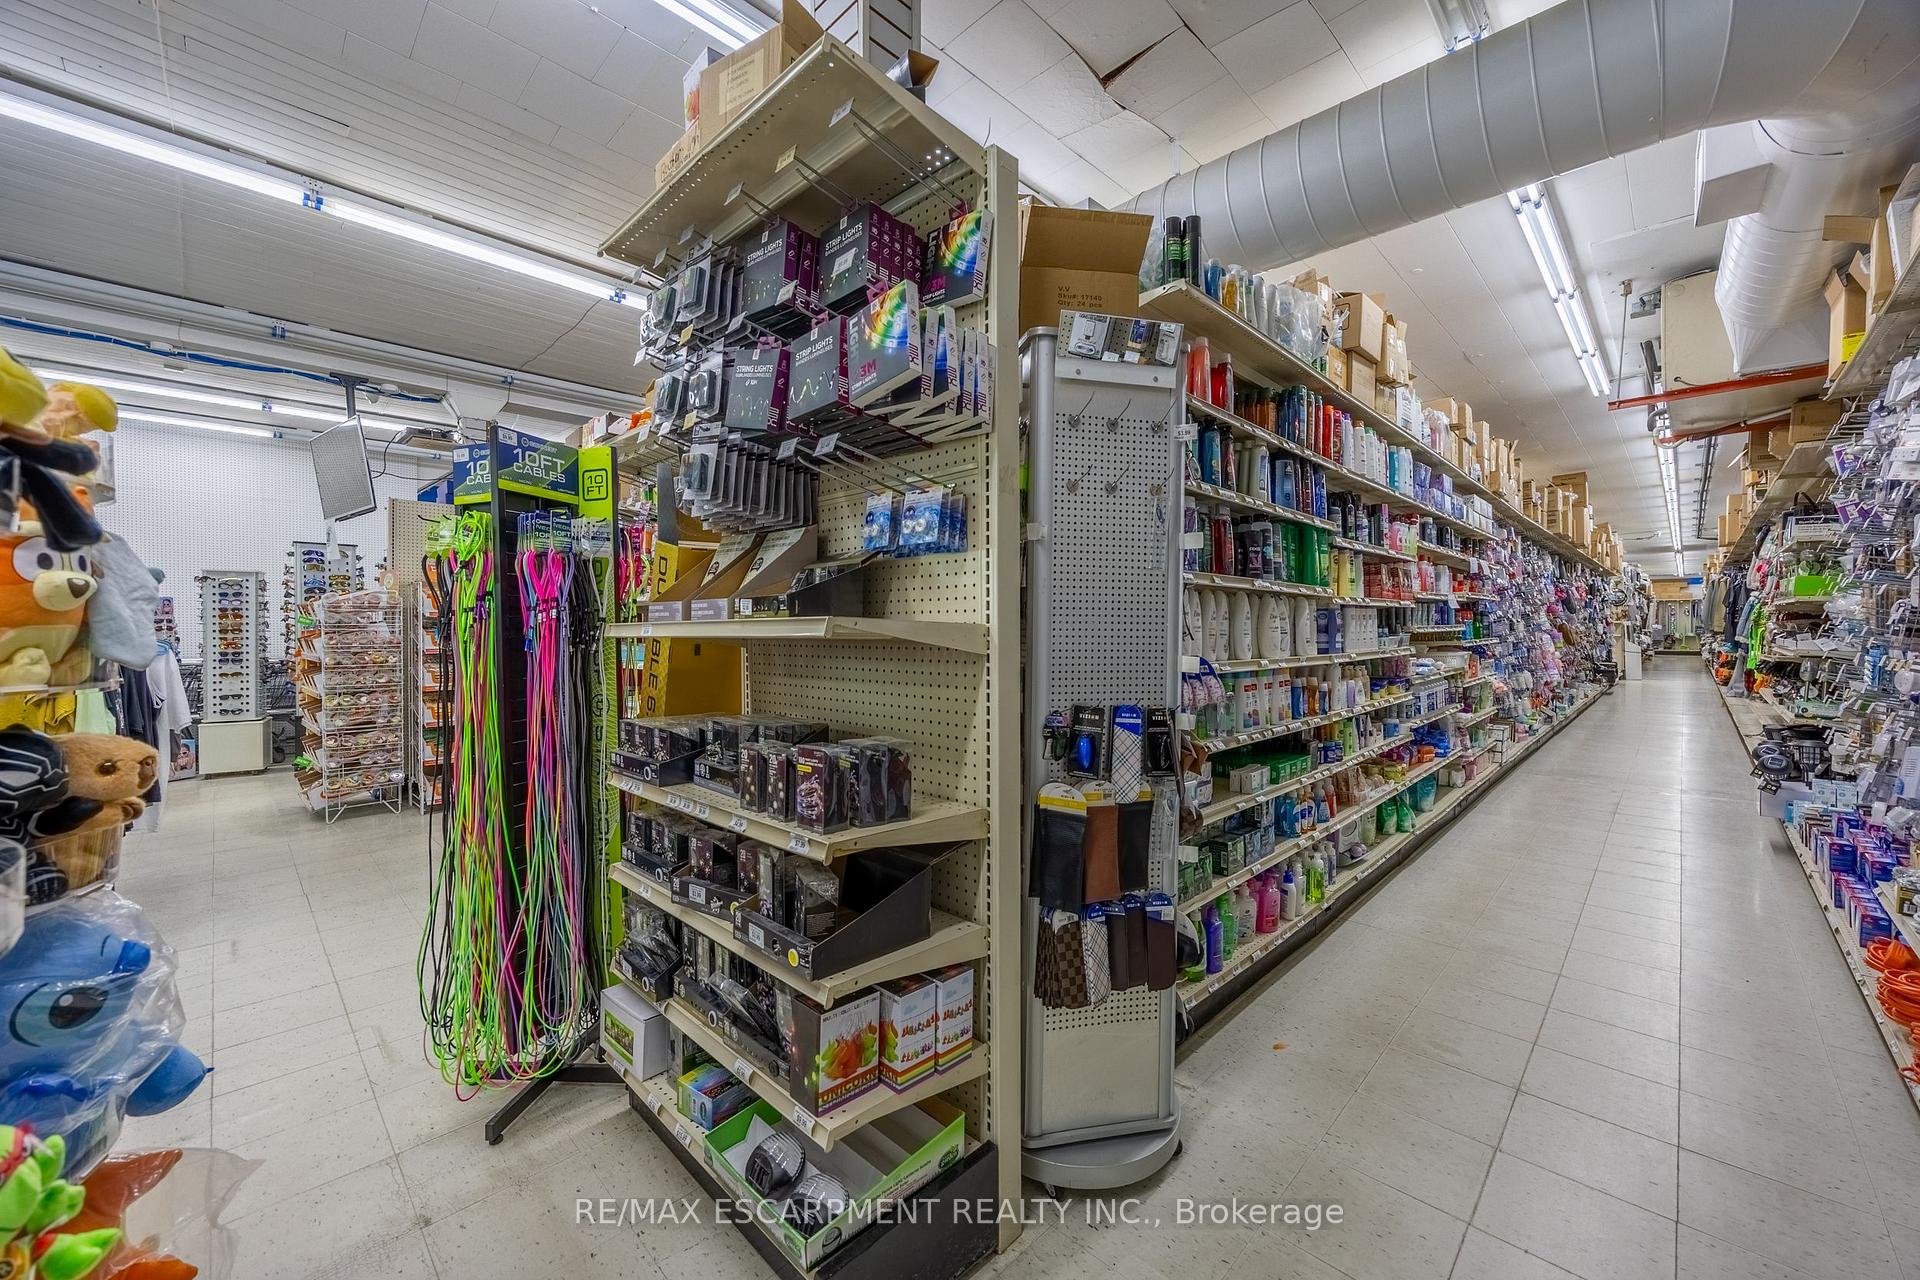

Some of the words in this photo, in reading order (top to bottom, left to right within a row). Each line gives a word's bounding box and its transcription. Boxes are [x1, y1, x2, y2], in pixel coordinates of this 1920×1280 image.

[842, 222, 863, 240] LIGHTS
[764, 239, 783, 257] LIGHTS
[812, 336, 834, 352] LIGHTS
[736, 365, 754, 373] STRING
[754, 364, 774, 373] LIGHTS
[466, 460, 489, 475] 10
[513, 447, 566, 474] 10FT
[466, 474, 491, 485] CAB
[513, 462, 566, 483] CABLES
[588, 474, 604, 485] 10
[587, 486, 604, 497] FT
[553, 530, 571, 538] 10FT
